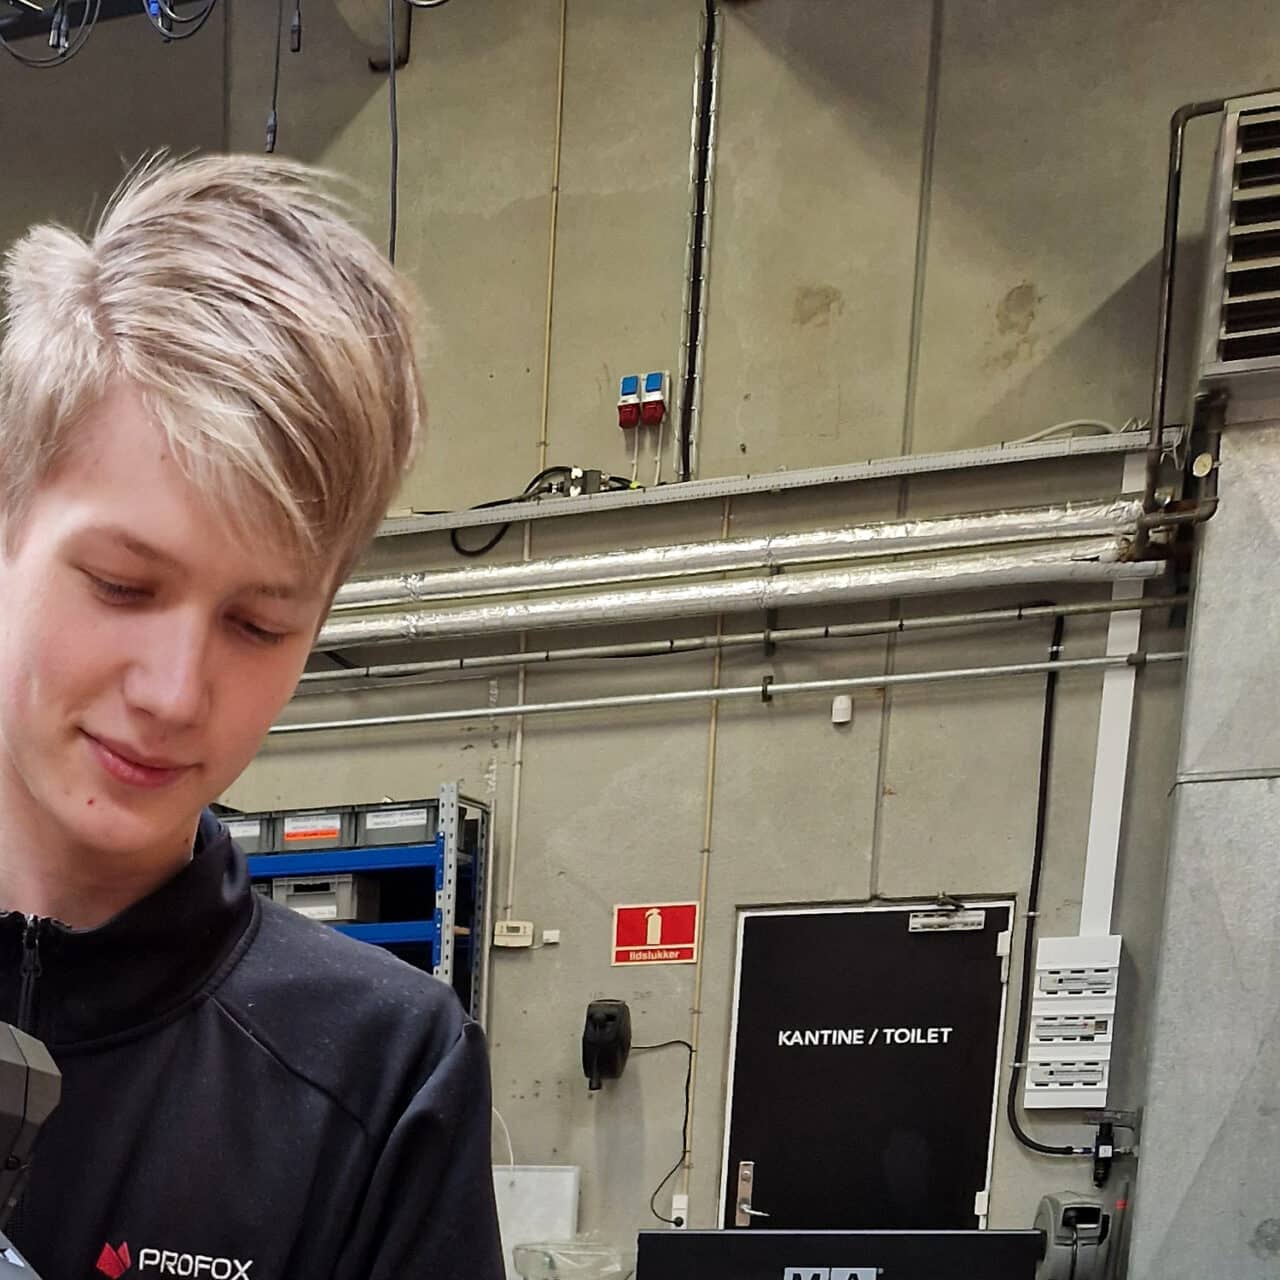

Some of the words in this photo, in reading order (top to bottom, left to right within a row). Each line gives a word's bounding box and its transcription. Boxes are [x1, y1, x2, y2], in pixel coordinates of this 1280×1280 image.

[778, 1029, 865, 1046] KANTINE
[868, 1028, 879, 1045] /
[882, 1027, 953, 1045] TOILET
